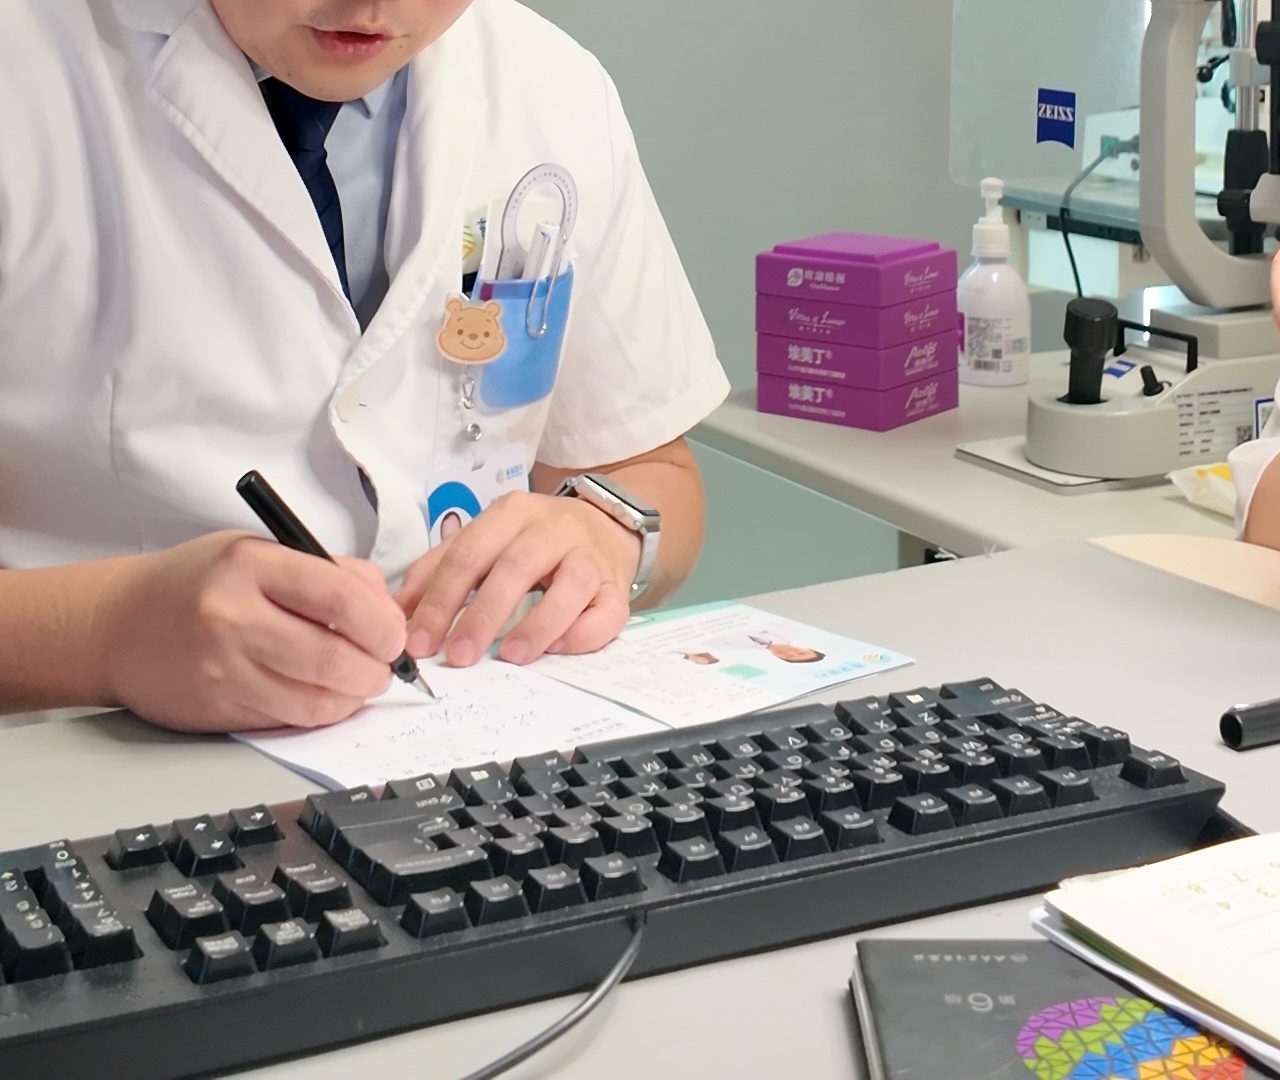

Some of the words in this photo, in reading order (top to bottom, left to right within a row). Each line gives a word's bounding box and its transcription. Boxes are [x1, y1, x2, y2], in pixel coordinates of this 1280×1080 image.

[1038, 102, 1074, 122] ZEISS
[4, 880, 18, 891] 2
[82, 890, 94, 900] 4
